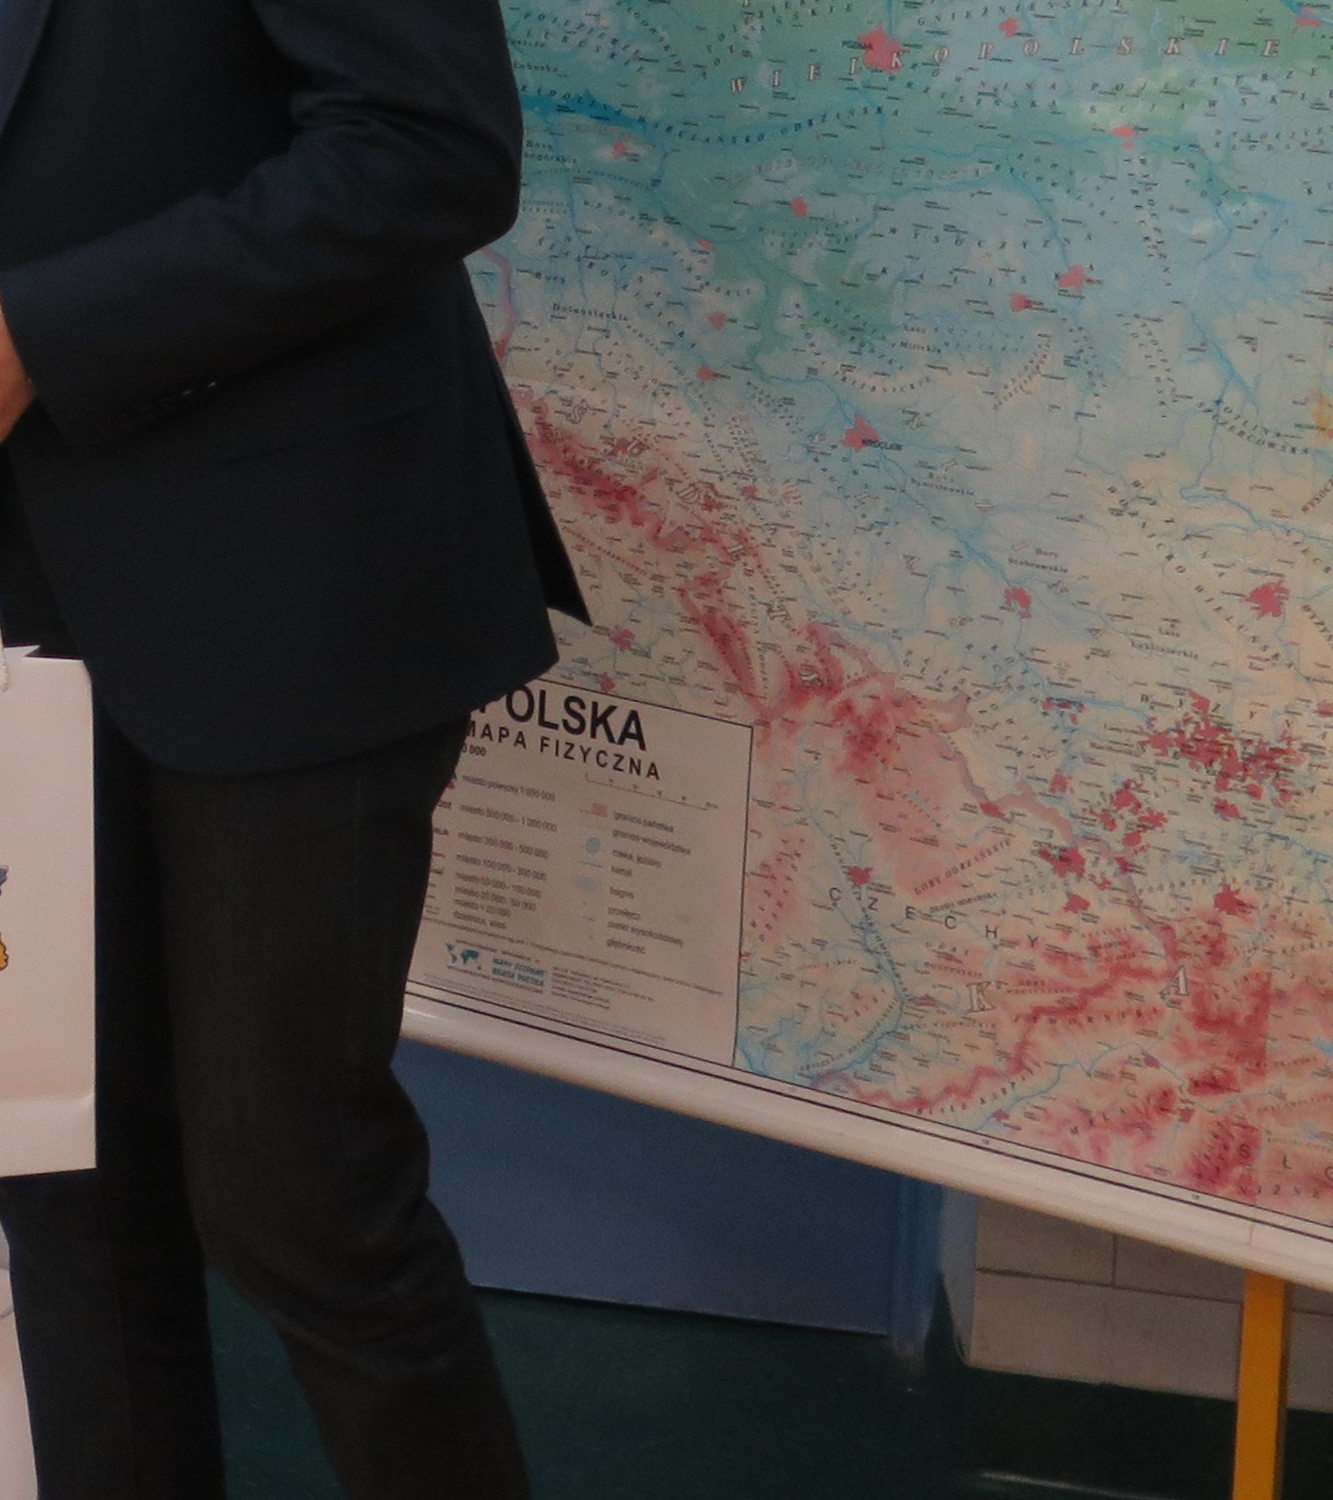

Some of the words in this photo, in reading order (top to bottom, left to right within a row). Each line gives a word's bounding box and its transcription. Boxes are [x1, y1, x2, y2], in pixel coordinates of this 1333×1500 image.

[466, 719, 528, 750] MAPA
[539, 735, 662, 781] FIZYCZNA
[479, 682, 647, 752] OLSKA
